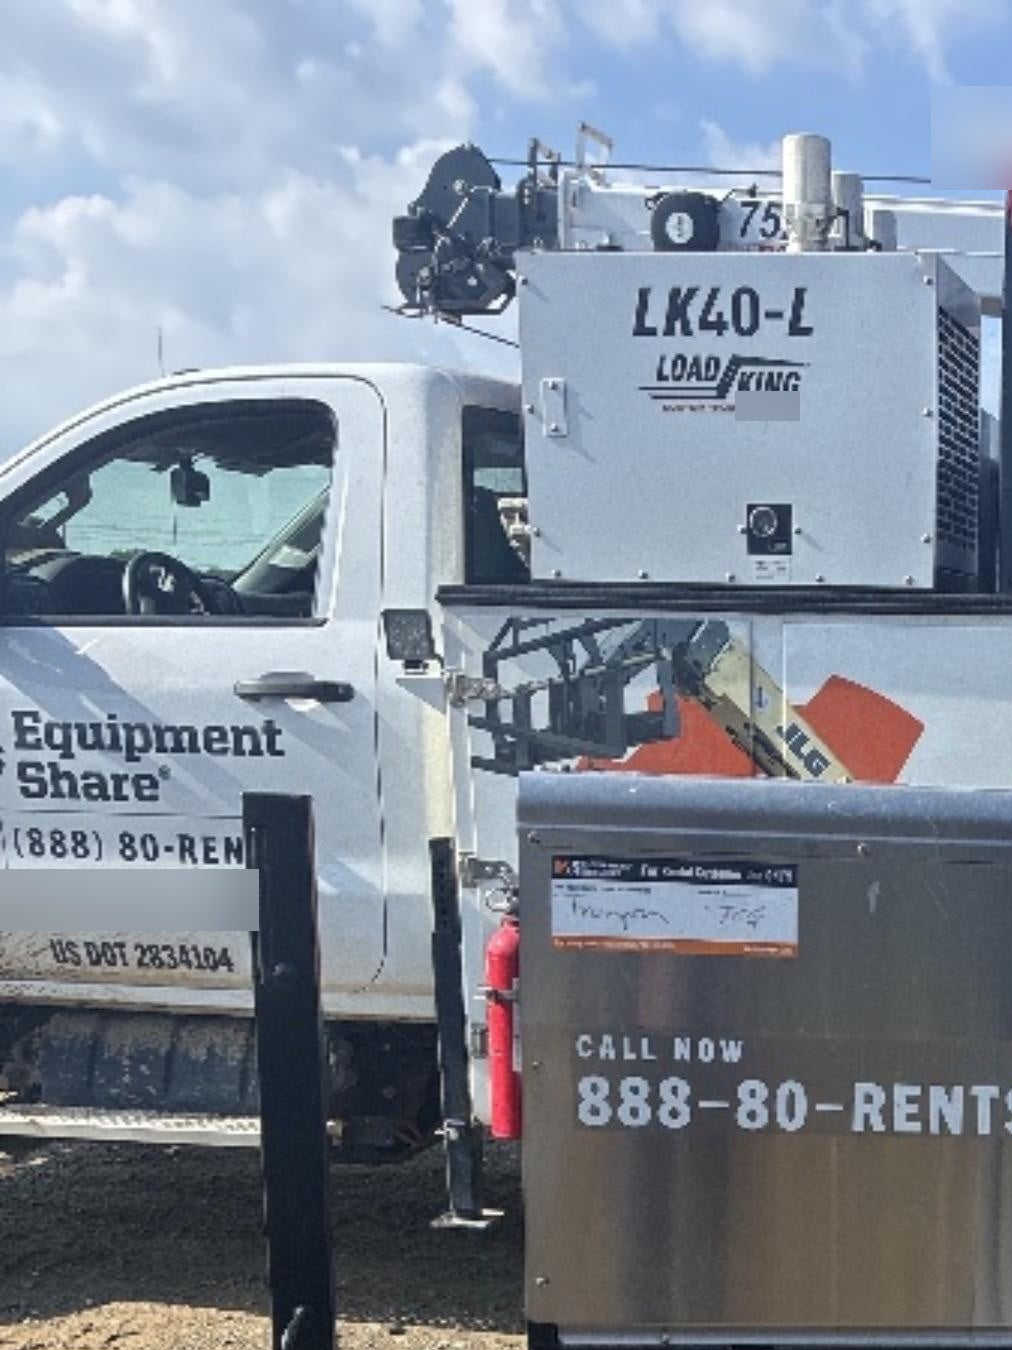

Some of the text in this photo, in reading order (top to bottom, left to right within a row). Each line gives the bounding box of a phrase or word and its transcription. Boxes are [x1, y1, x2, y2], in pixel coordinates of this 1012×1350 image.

[740, 201, 788, 239] 75
[632, 286, 814, 337] LK40-L
[656, 353, 720, 382] LOAD
[737, 371, 801, 391] KING
[11, 710, 286, 762] Equipment
[13, 827, 244, 865] (888) 80-REN
[50, 939, 234, 972] US DOT 2834104
[575, 1034, 744, 1063] CALL NOW
